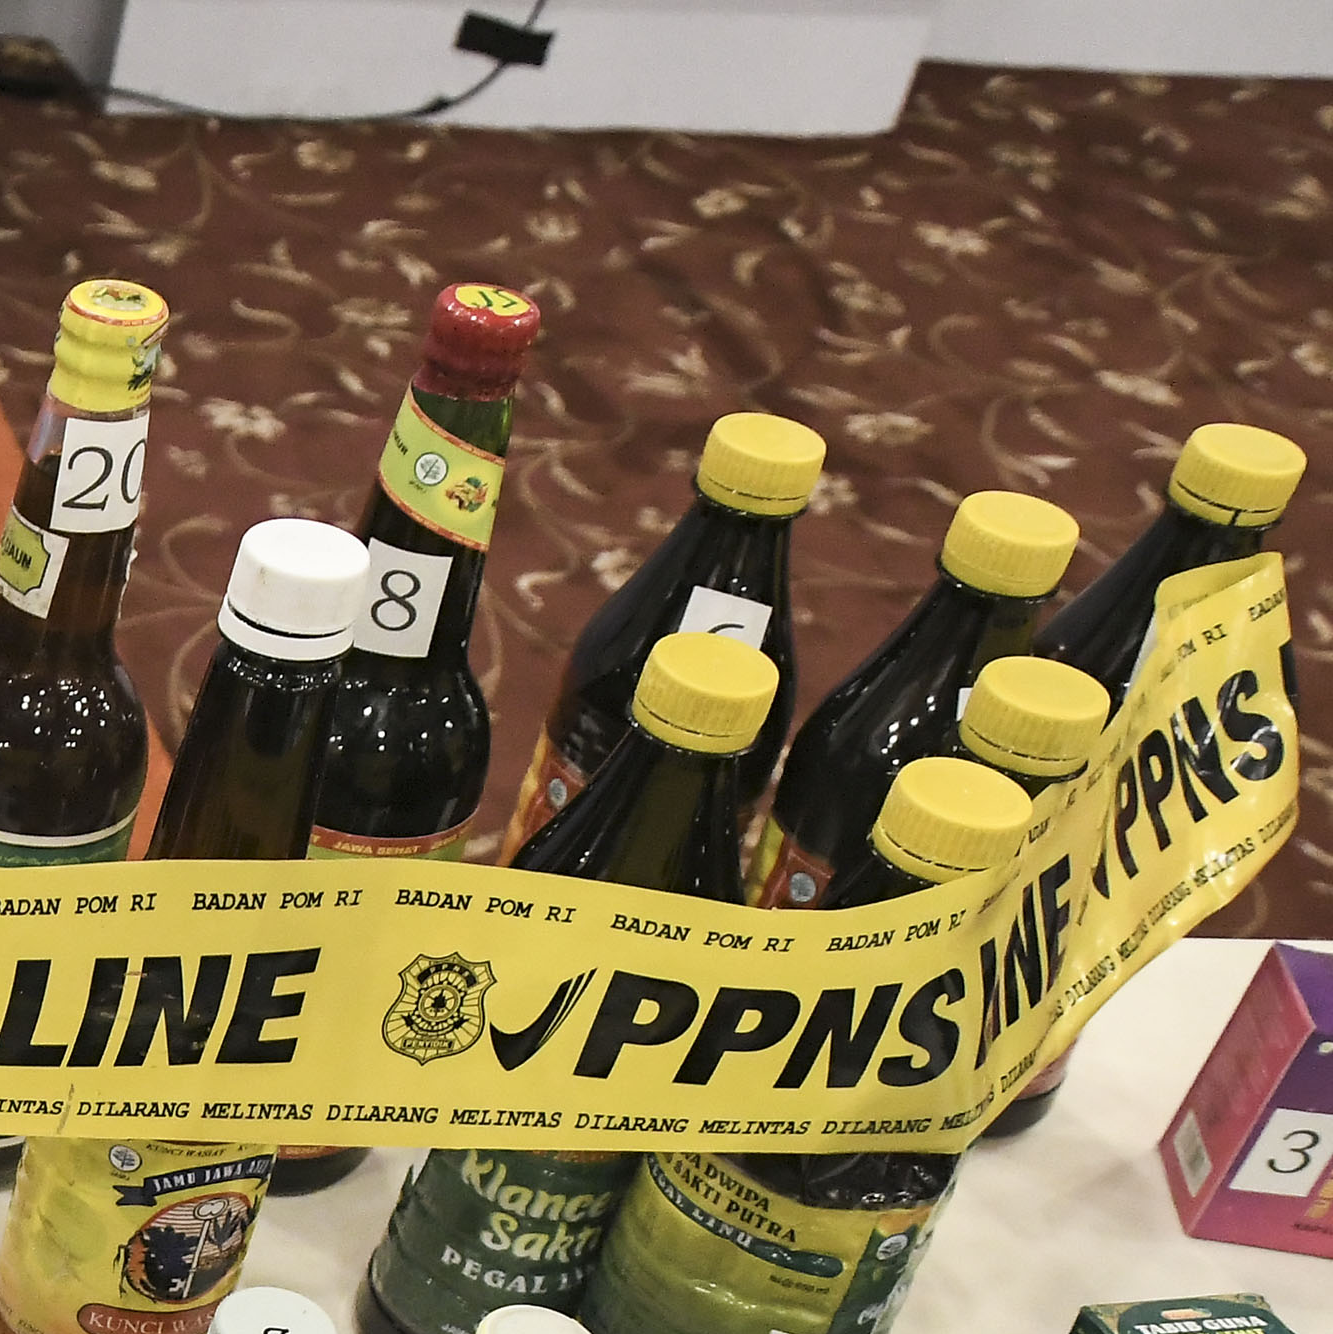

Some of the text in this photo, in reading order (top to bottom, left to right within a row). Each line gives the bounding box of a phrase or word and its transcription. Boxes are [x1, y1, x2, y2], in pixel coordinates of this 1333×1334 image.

[371, 570, 421, 631] 8
[1116, 669, 1284, 880] PPNS
[334, 842, 373, 855] JAWA
[192, 890, 362, 910] BADAN POM RI
[611, 913, 795, 952] BADAN POM RI
[573, 966, 967, 1089] PPNS
[575, 1113, 688, 1133] DILARANG
[699, 1120, 810, 1135] MELINTAS
[153, 1162, 243, 1192] JAMU JAWA
[703, 1162, 771, 1212] DWIPA
[673, 1158, 798, 1244] SAKTI PUTRA
[442, 1245, 547, 1294] PEGAL
[1206, 1315, 1269, 1331] GUNA
